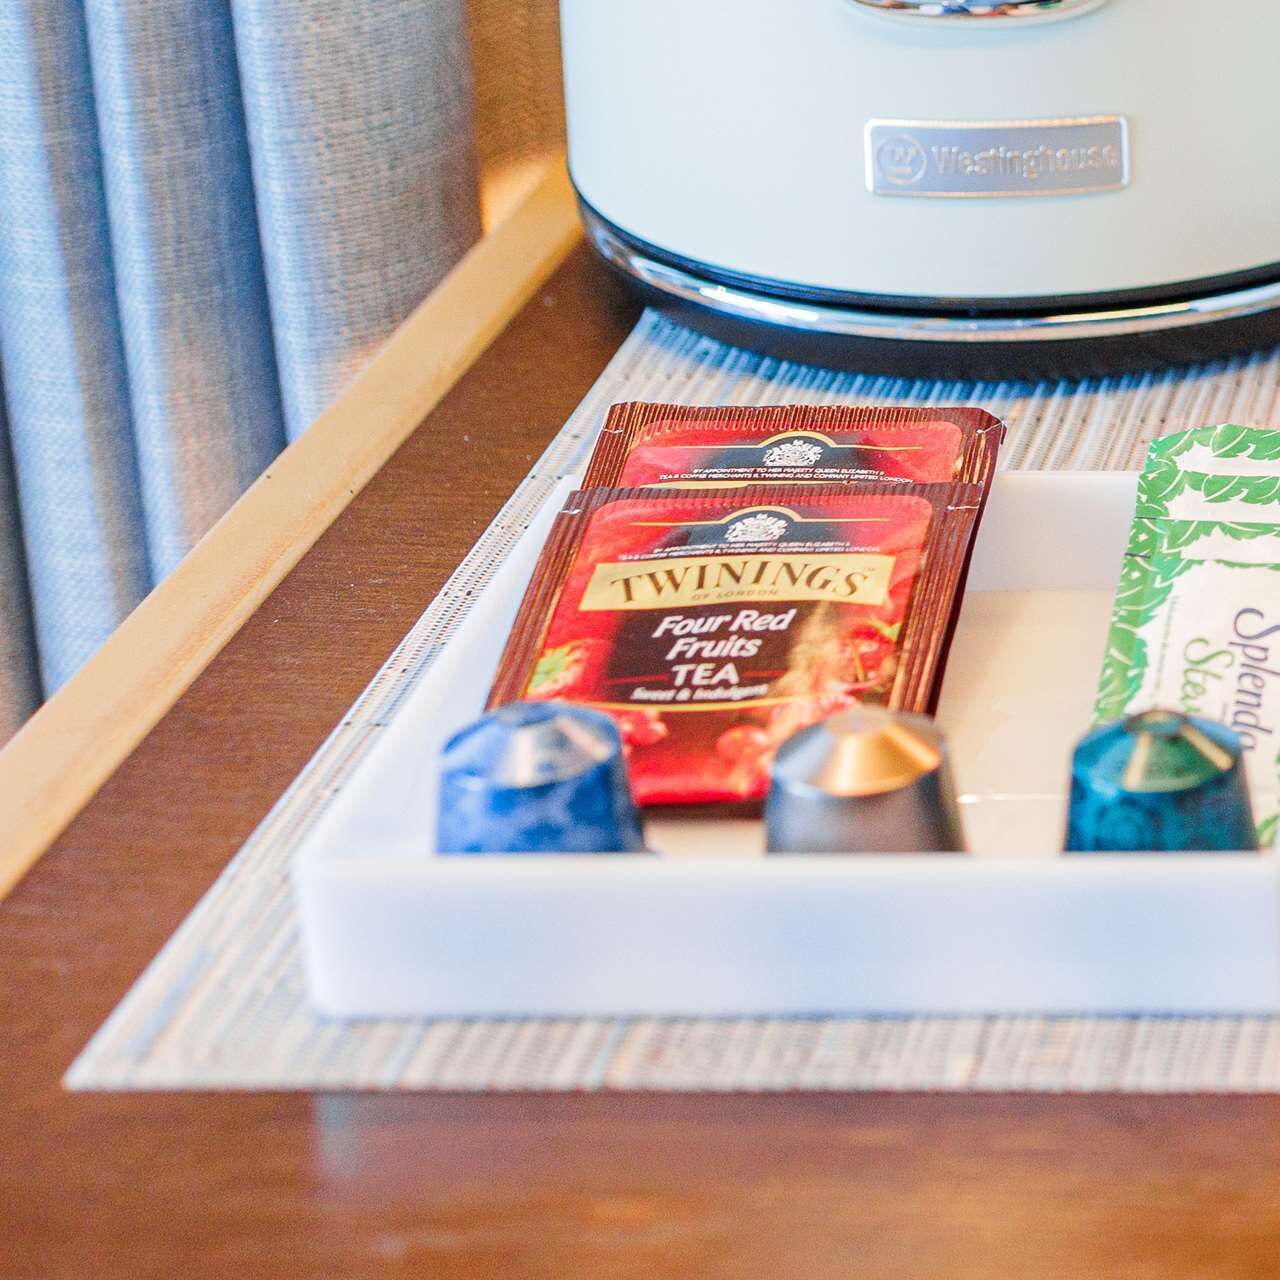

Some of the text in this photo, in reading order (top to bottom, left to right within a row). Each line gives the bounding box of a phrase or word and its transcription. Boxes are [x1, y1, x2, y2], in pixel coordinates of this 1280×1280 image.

[930, 143, 1119, 182] Westinghouse
[610, 560, 869, 603] TWININGS
[651, 608, 798, 639] Four Red
[664, 634, 763, 661] Fruits
[671, 662, 740, 687] TEA
